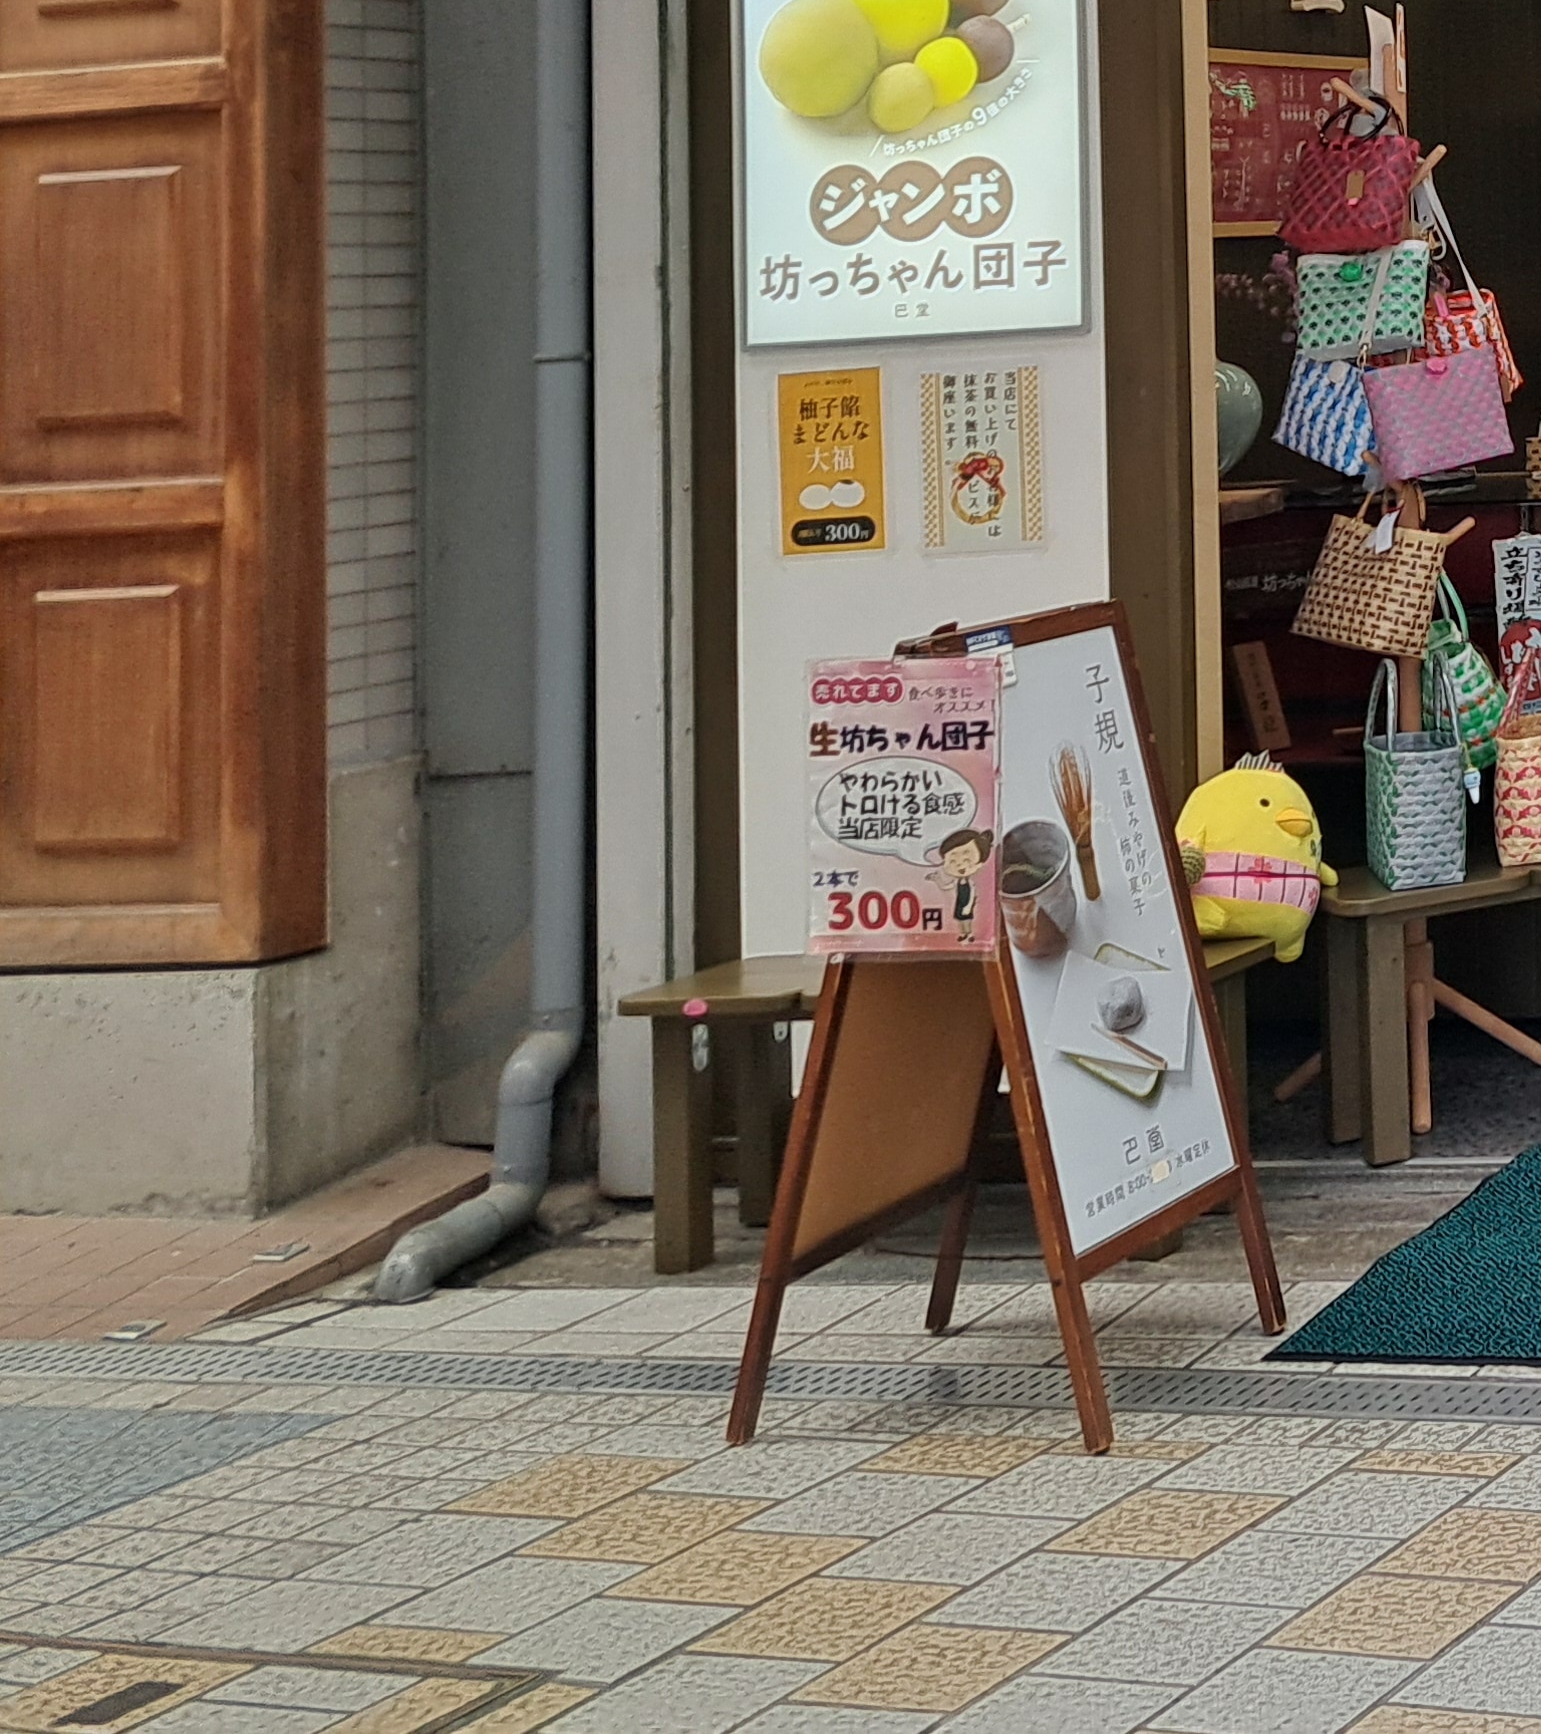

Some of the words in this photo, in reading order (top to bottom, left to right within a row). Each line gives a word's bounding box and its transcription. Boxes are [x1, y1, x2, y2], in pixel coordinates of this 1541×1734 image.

[820, 171, 1002, 232] ジャンボ
[759, 239, 1067, 302] 坊っちゃん団子
[799, 395, 860, 421] 柚子餡
[1004, 371, 1017, 431] 当店にて
[793, 420, 870, 444] まどんな
[806, 445, 855, 474] 大福
[825, 523, 870, 541] 300円
[815, 681, 899, 701] 売れてます
[908, 686, 974, 701] 食べ歩きに
[1086, 664, 1125, 754] 子規
[809, 720, 995, 757] 生坊ちゃん団子
[839, 770, 943, 793] やわらかい
[841, 792, 965, 816] トロける食感
[838, 816, 923, 840] 当店限定
[813, 869, 860, 887] 2本で
[828, 890, 943, 931] 300円
[1123, 1123, 1164, 1165] 巴堂
